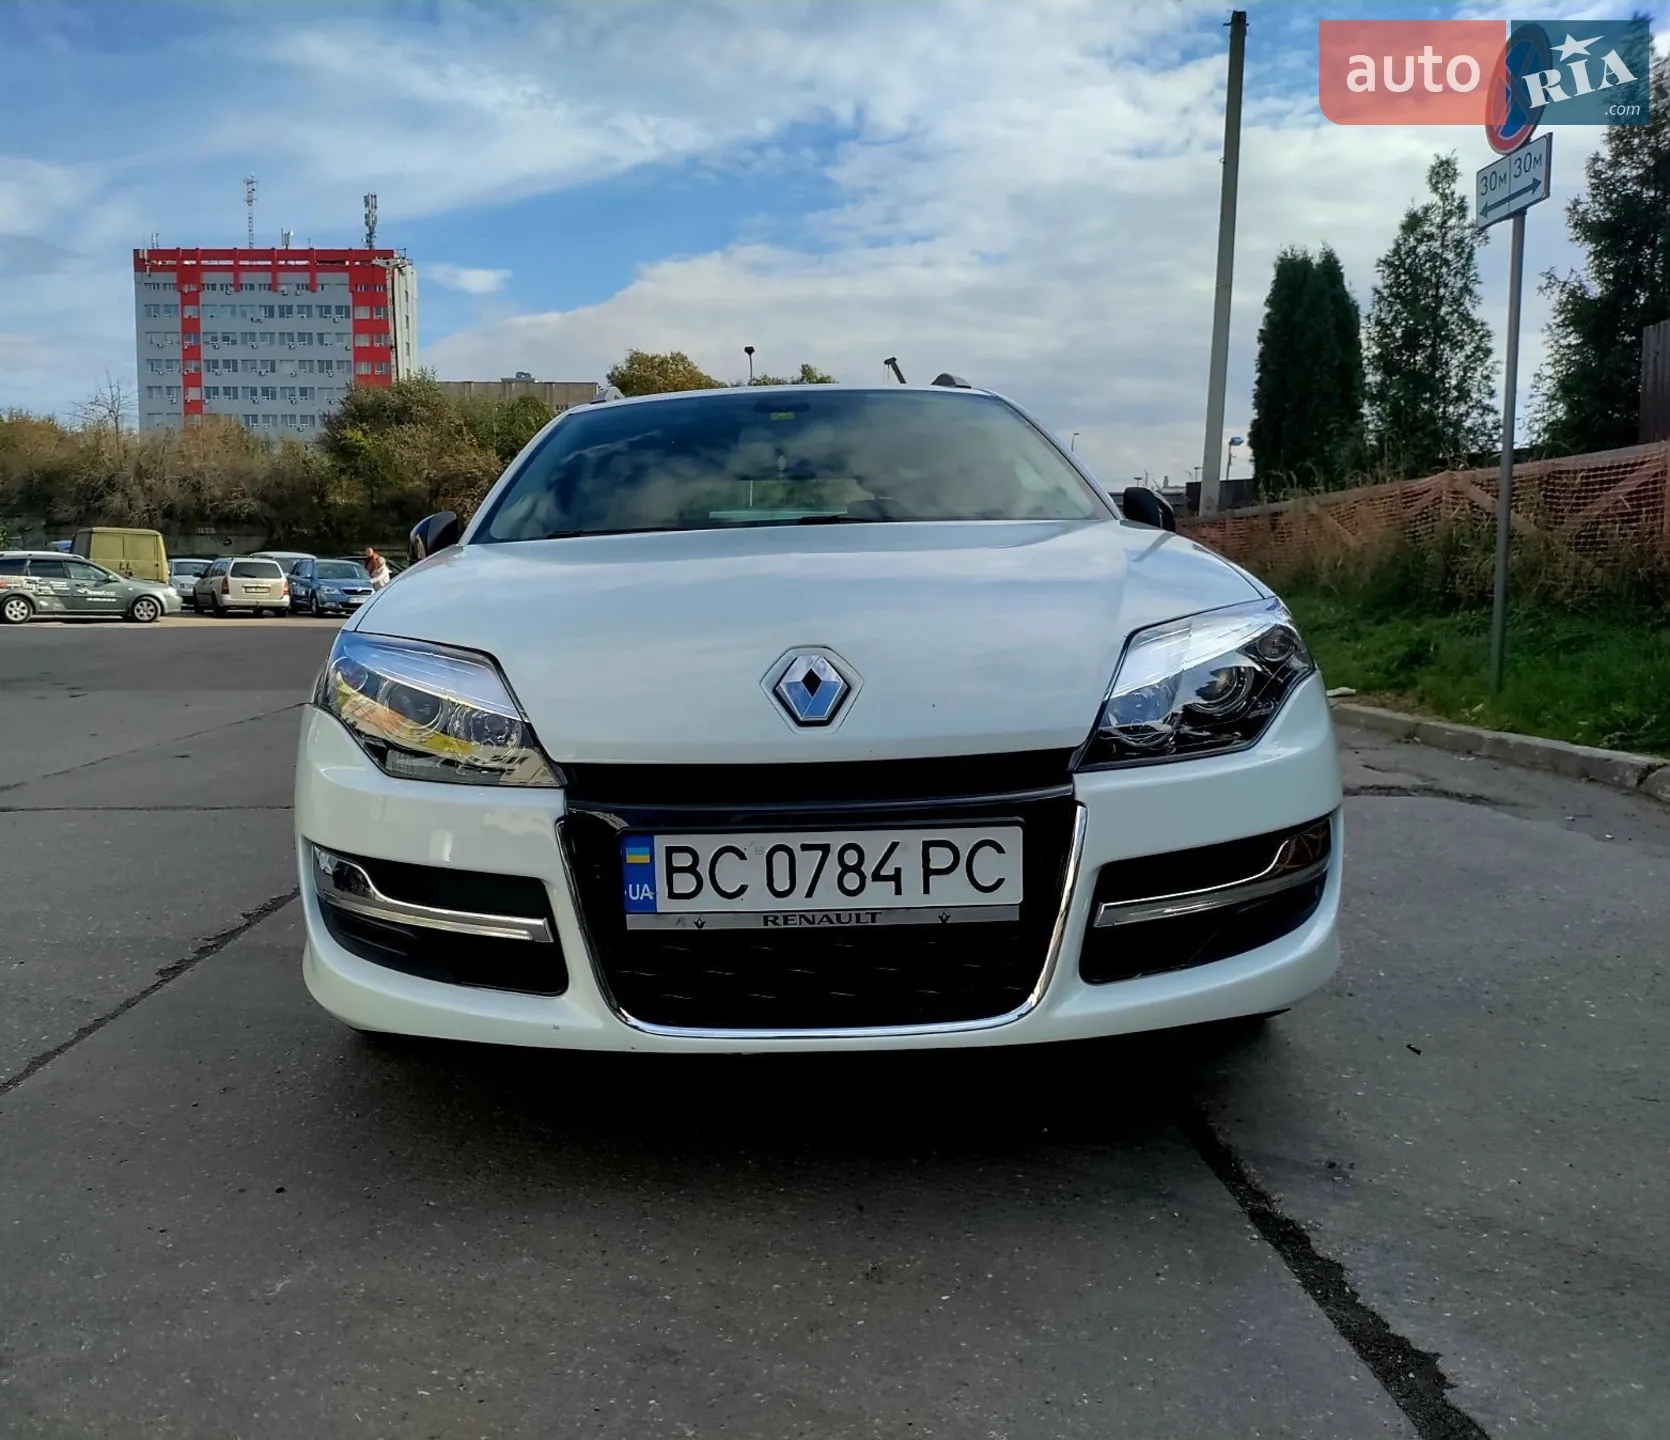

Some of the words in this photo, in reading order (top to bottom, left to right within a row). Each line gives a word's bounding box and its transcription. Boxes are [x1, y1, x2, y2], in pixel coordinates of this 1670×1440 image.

[664, 845, 749, 901] BC
[765, 841, 903, 899] 0784
[922, 839, 1007, 895] PC
[628, 883, 654, 901] UA
[762, 911, 883, 927] RENAULT
